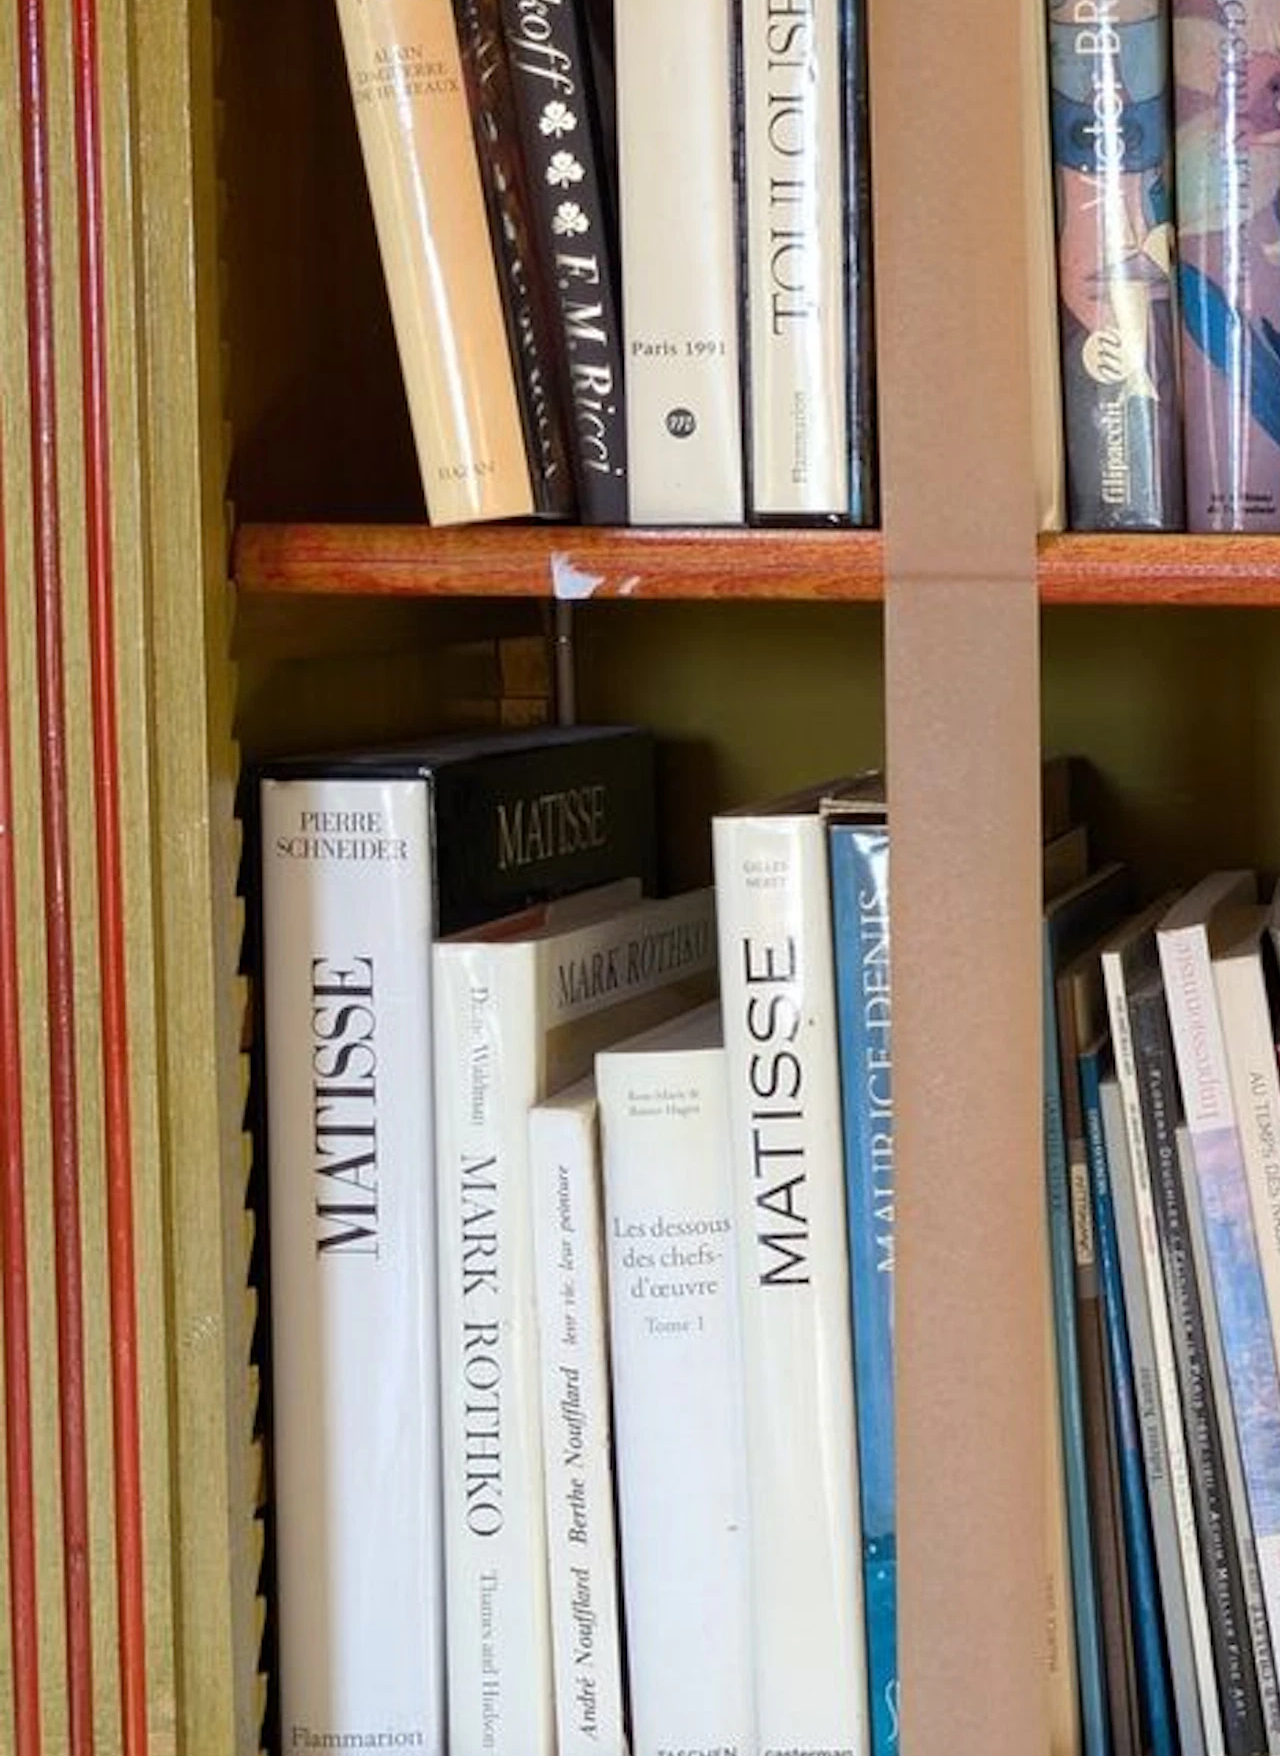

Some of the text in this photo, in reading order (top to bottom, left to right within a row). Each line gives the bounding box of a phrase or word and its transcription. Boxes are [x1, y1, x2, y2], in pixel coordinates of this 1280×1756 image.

[632, 339, 727, 357] Paris 1991
[299, 810, 384, 834] PIERRE
[276, 837, 408, 862] SCHNEIDER
[309, 954, 381, 1262] MATISSE
[742, 936, 812, 1288] MATISSE
[612, 1215, 733, 1241] Les dessous
[621, 1245, 724, 1270] des chefs-
[645, 1316, 692, 1335] Tome
[460, 1154, 505, 1540] MARK ROTHKO
[562, 1365, 600, 1741] André Noufflard Berthe Noufflard
[289, 1726, 425, 1750] Flammarion
